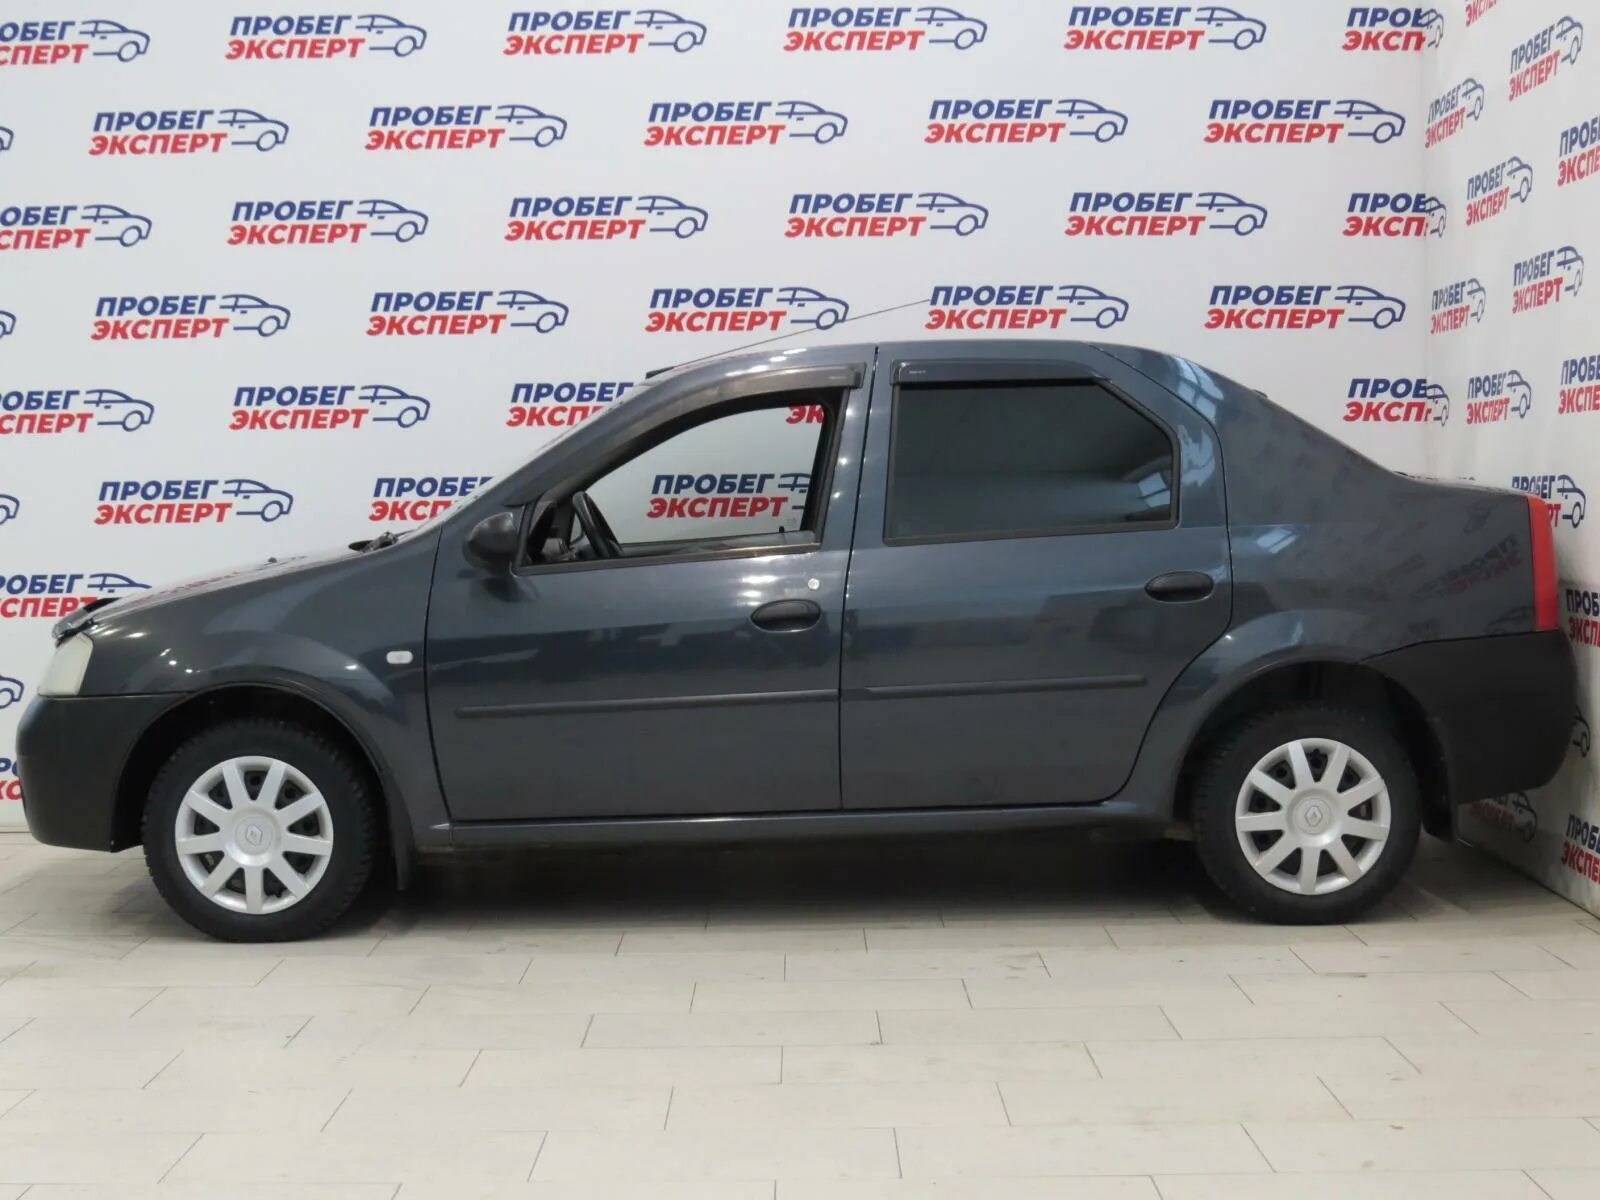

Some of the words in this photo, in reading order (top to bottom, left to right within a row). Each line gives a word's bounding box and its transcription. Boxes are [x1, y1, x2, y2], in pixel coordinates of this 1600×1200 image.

[230, 16, 352, 36] ПРОБЕГ
[509, 11, 631, 32] ПРОБЕГ
[788, 8, 912, 28] ПРОБЕГ
[1068, 7, 1191, 27] ПРОБЕГ
[0, 21, 76, 43] ОБЕГ
[783, 29, 926, 53] ЭКСПЕРТ
[1063, 28, 1206, 52] ЭКСПЕРТ
[1343, 31, 1426, 53] ЭКСП
[0, 43, 90, 66] СПЕРТ
[225, 36, 367, 61] ЭКСПЕРТ
[503, 32, 646, 56] ЭКСПЕРТ
[1510, 24, 1555, 74] ПРОБЕГ
[1508, 50, 1561, 102] ЭКСПЕРТ
[649, 102, 770, 123] ПРОБЕГ
[929, 99, 1052, 120] ПРОБЕГ
[1209, 99, 1331, 120] ПРОБЕГ
[1428, 85, 1461, 124] ПРОБЕГ
[93, 110, 214, 132] ПРОБЕГ
[370, 106, 492, 127] ПРОБЕГ
[1425, 106, 1466, 149] ЭКСПЕРТ
[89, 132, 228, 157] ЭКСПЕРТ
[365, 128, 506, 151] ЭКСПЕРТ
[643, 124, 786, 148] ЭКСПЕРТ
[924, 122, 1066, 145] ЭКСПЕРТ
[1203, 122, 1345, 144] ЭКСПЕРТ
[1559, 114, 1600, 157] ПРОБ
[1557, 146, 1600, 187] ЭКСПЕ
[1467, 162, 1506, 201] ПРОБЕГ
[232, 200, 353, 221] ПРОБЕГ
[510, 196, 631, 217] ПРОБЕГ
[790, 193, 913, 214] ПРОБЕГ
[1070, 192, 1193, 213] ПРОБЕГ
[1466, 186, 1510, 226] ЭКСПЕРТ
[0, 206, 78, 227] ОБЕГ
[784, 216, 928, 239] ЭКСПЕРТ
[1065, 214, 1207, 237] ЭКСПЕРТ
[1343, 215, 1428, 238] ЭКСП
[0, 228, 92, 251] СПЕРТ
[227, 223, 367, 246] ЭКСПЕРТ
[504, 219, 646, 242] ЭКСПЕРТ
[1513, 250, 1555, 286] ПРОБЕГ
[95, 295, 215, 317] ПРОБЕГ
[371, 291, 491, 312] ПРОБЕГ
[650, 287, 770, 309] ПРОБЕГ
[930, 285, 1054, 306] ПРОБЕГ
[1210, 285, 1331, 306] ПРОБЕГ
[1431, 281, 1466, 311] ПРОБЕГ
[1512, 277, 1563, 314] ЭКСПЕРТ
[90, 318, 230, 341] ЭКСПЕРТ
[367, 314, 507, 336] ЭКСПЕРТ
[644, 311, 787, 334] ЭКСПЕРТ
[924, 308, 1068, 331] ЭКСПЕРТ
[1204, 307, 1345, 330] ЭКСПЕРТ
[1430, 304, 1470, 335] ЭКСПЕРТ
[234, 385, 354, 407] ПРОБЕГ
[511, 382, 634, 404] ПРОБЕГ
[1467, 371, 1507, 400] ПРОБЕГ
[0, 390, 79, 411] ОБЕГ
[1466, 398, 1510, 425] ЭКСПЕРТ
[1558, 385, 1600, 415] ЭКСПЕ
[228, 408, 369, 431] ЭКСПЕРТ
[506, 404, 604, 428] ЭКСП
[1343, 401, 1434, 423] ЭКСП
[0, 413, 96, 435] СПЕРТ
[98, 479, 219, 502] ПРОБЕГ
[651, 473, 775, 495] ПРОБЕГ
[95, 502, 232, 526] ЭКСПЕРТ
[369, 499, 453, 523] ЭКСП
[647, 497, 787, 519] ЭКСПЕРТ
[0, 574, 83, 595] ОБЕГ
[1565, 589, 1600, 617] ПРОБ
[1566, 814, 1600, 854] ПРОБ
[1560, 840, 1600, 885] ЭКСПЕ
